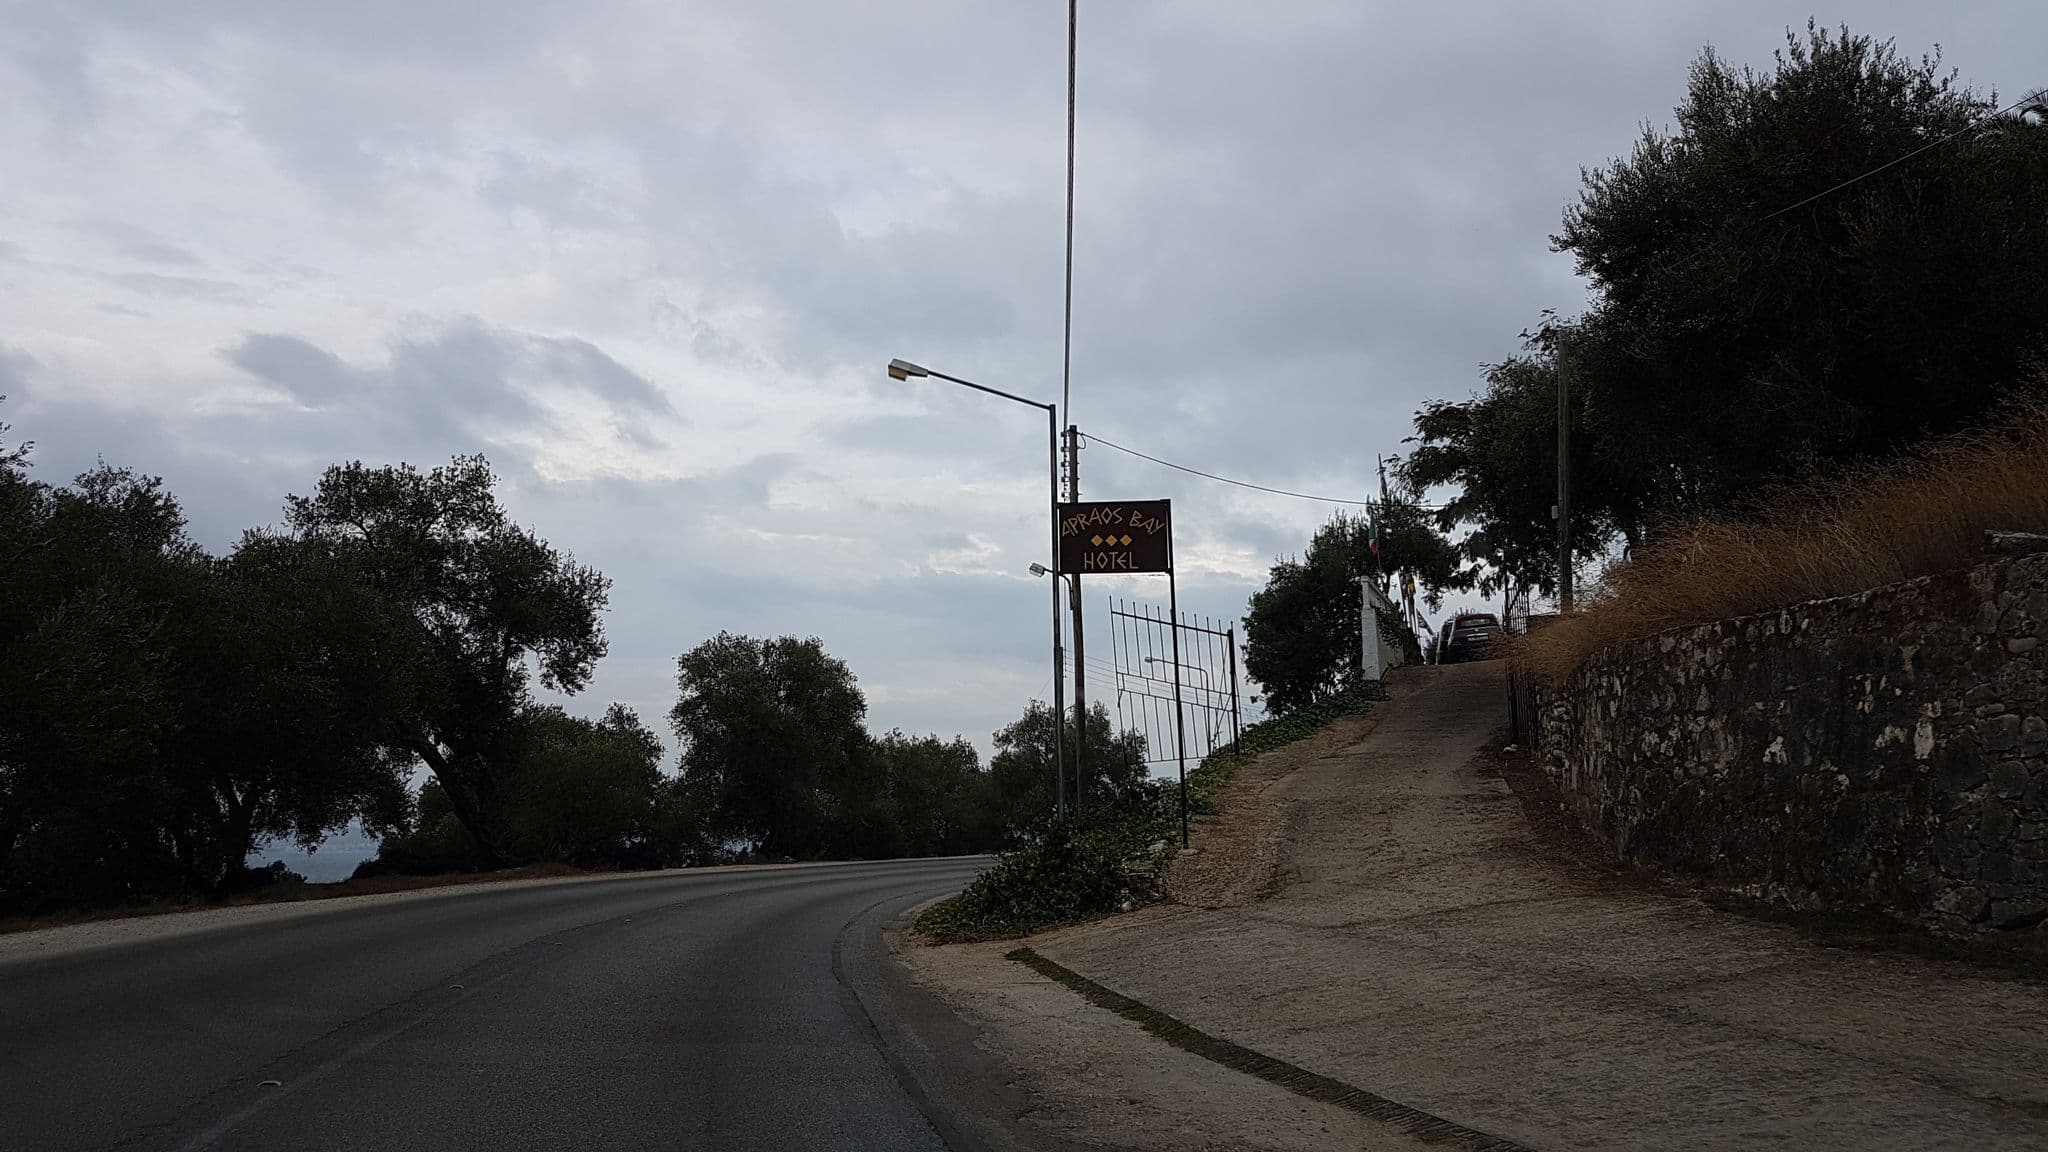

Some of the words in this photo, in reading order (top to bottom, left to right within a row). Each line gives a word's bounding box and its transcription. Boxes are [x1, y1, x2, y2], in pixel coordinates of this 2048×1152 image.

[1062, 507, 1123, 537] APRAOS
[1129, 510, 1165, 535] BAY
[1084, 551, 1139, 569] HOTEL
